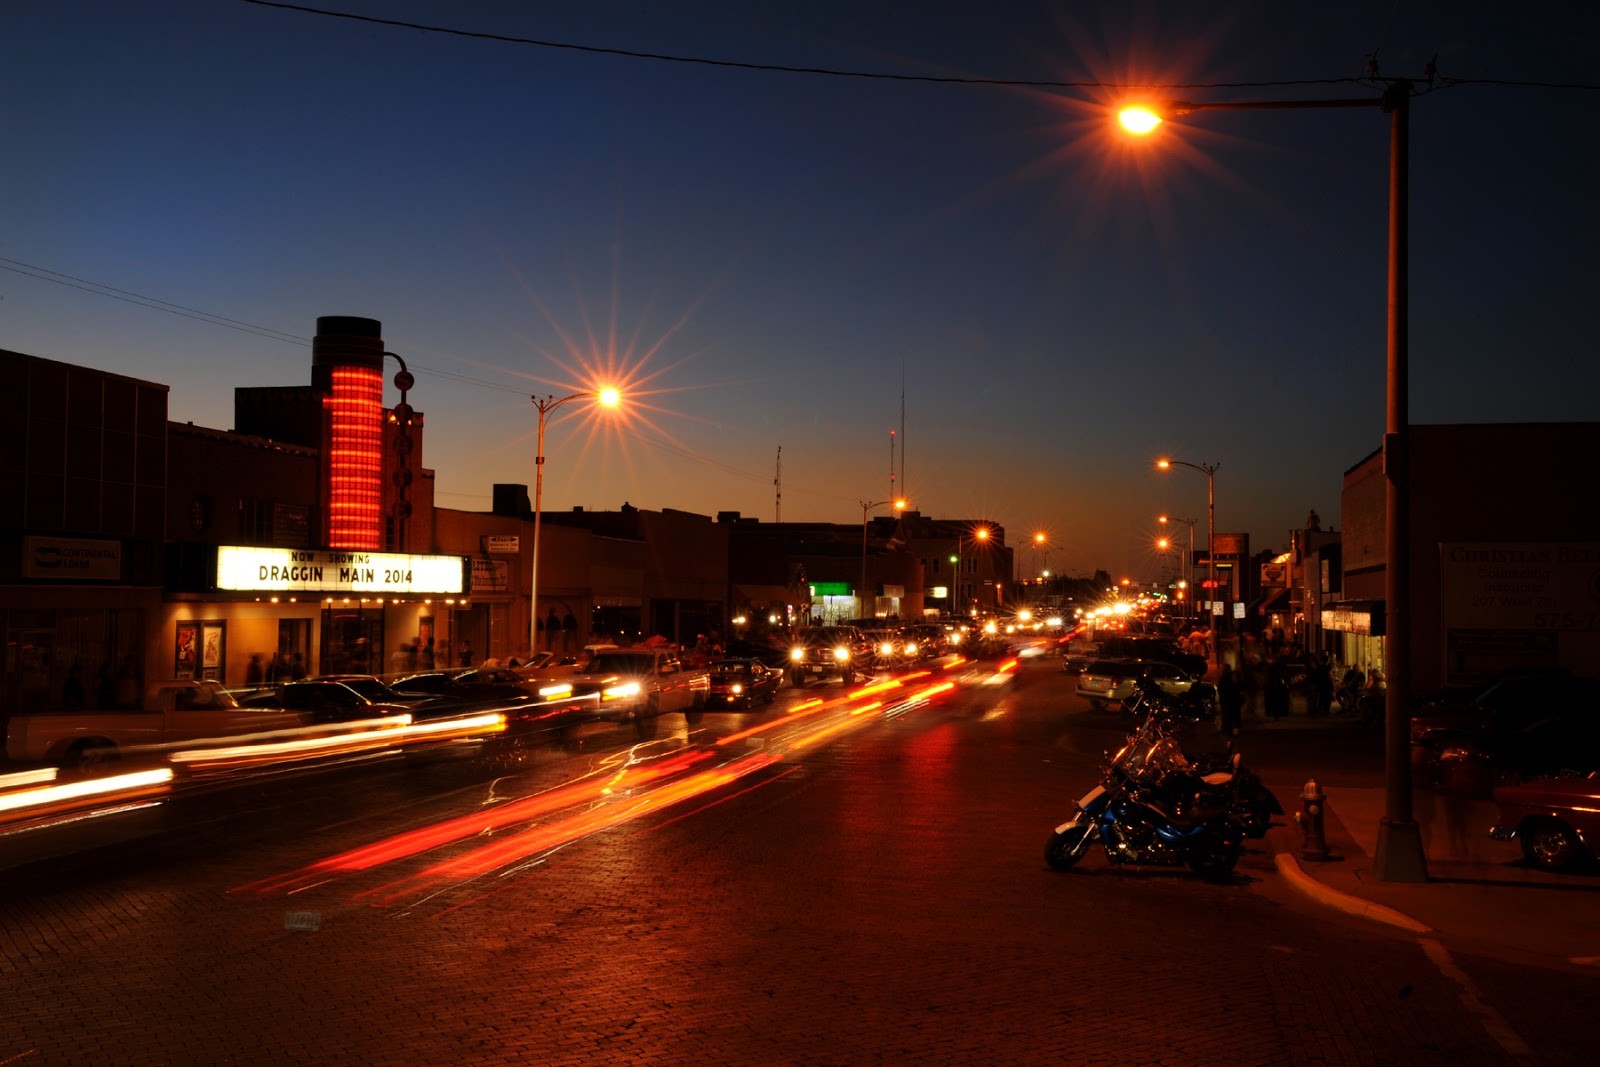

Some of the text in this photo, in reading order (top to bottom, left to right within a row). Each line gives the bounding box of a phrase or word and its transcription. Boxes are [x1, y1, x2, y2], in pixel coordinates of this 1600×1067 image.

[62, 547, 116, 560] CONTINENTAL
[291, 551, 370, 564] NOW SHOWING
[1450, 547, 1551, 562] CHRISTIAN
[259, 565, 413, 584] DRAGGIN MAIN 2014
